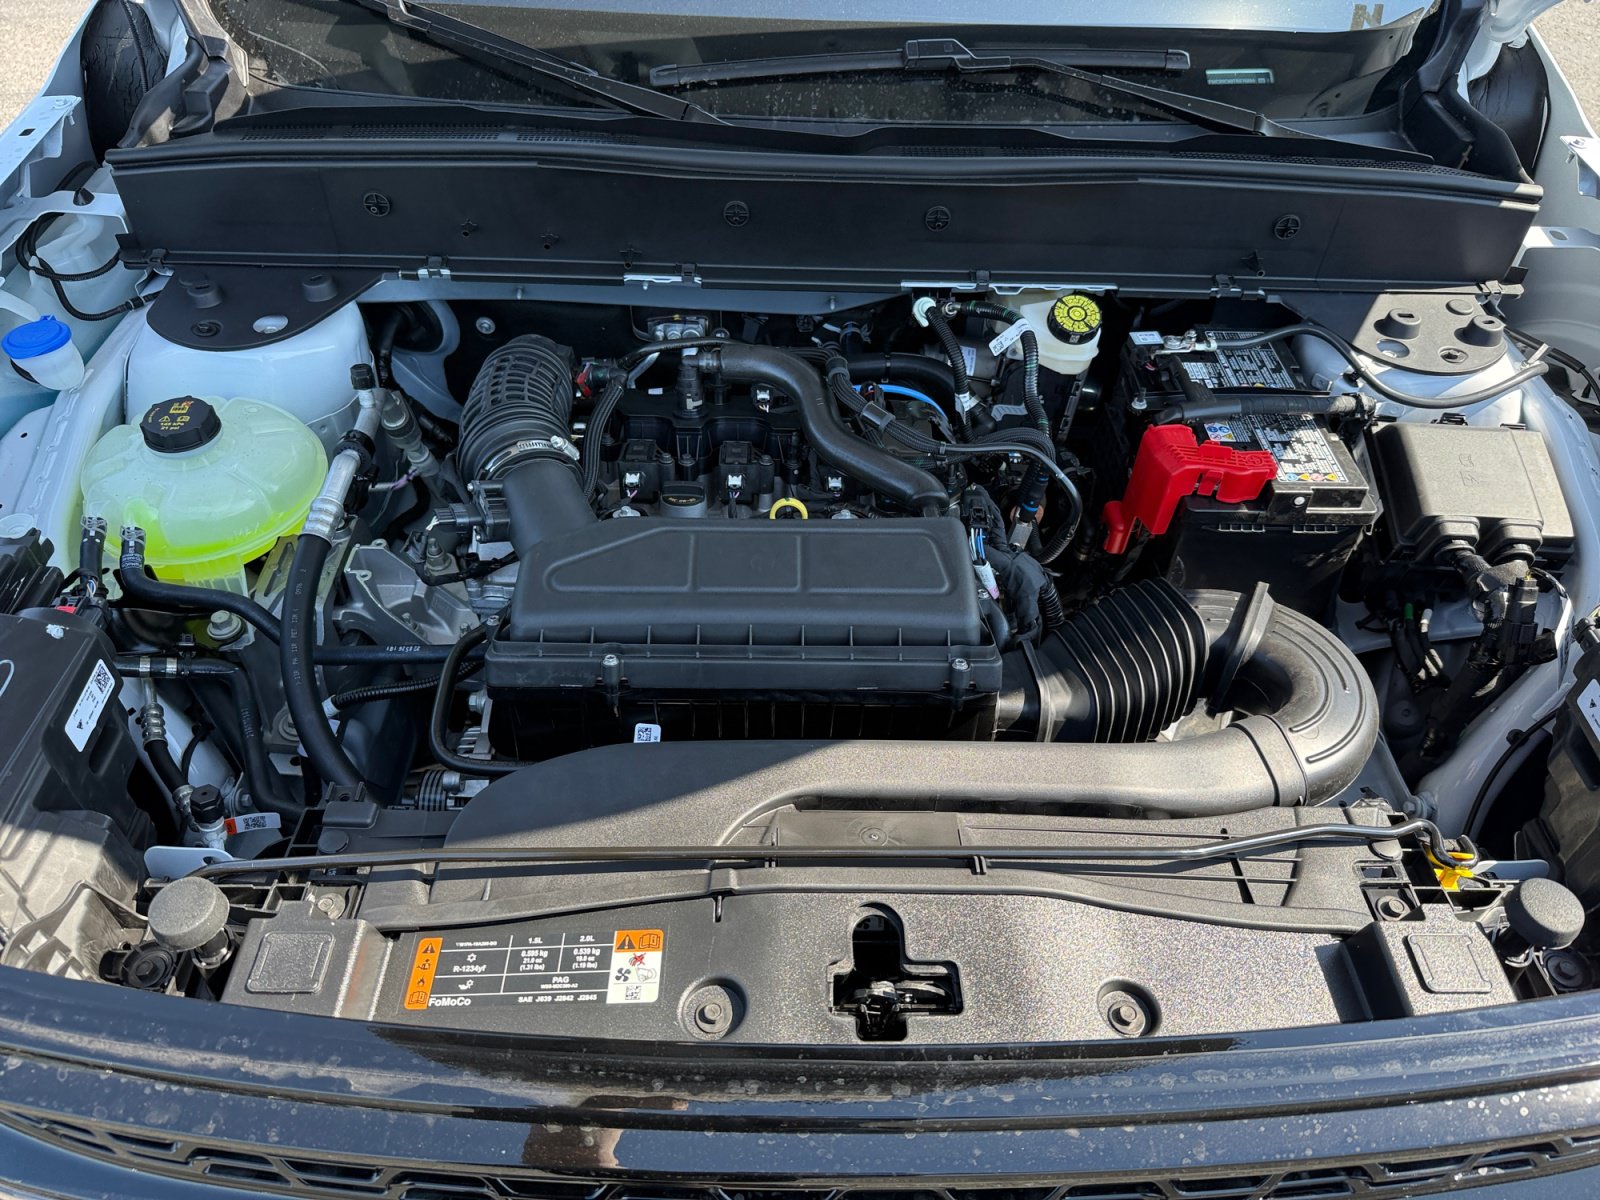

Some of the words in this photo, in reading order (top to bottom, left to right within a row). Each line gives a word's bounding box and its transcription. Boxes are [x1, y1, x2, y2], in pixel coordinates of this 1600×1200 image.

[539, 950, 549, 958] kg
[591, 948, 601, 956] kg
[453, 965, 487, 973] R-1234yf
[428, 997, 472, 1007] FoMoCo
